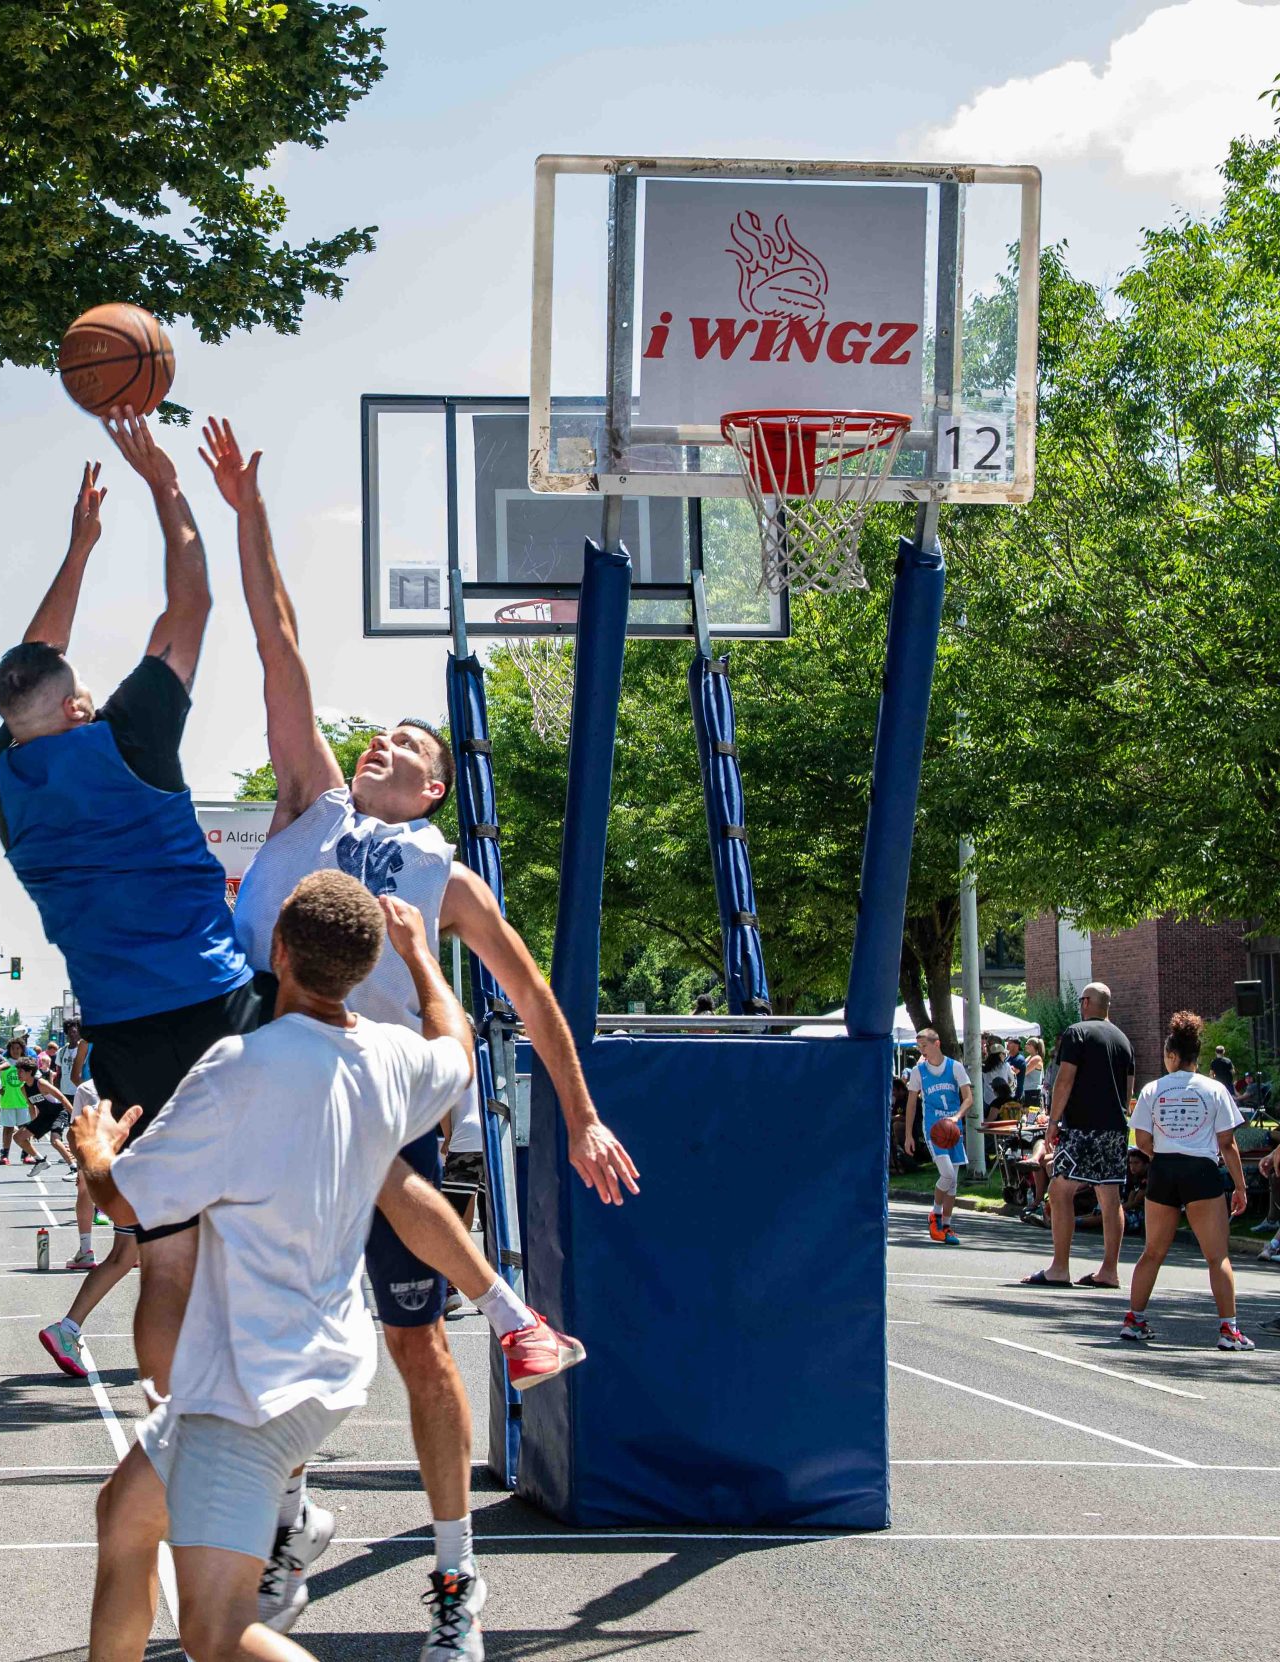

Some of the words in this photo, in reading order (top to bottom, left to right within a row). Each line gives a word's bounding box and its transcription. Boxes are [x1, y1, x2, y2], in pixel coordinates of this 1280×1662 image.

[643, 311, 673, 359] i
[688, 316, 919, 365] WINGZ
[944, 425, 1003, 471] 12
[226, 831, 269, 843] Aldric
[940, 1094, 948, 1110] 1
